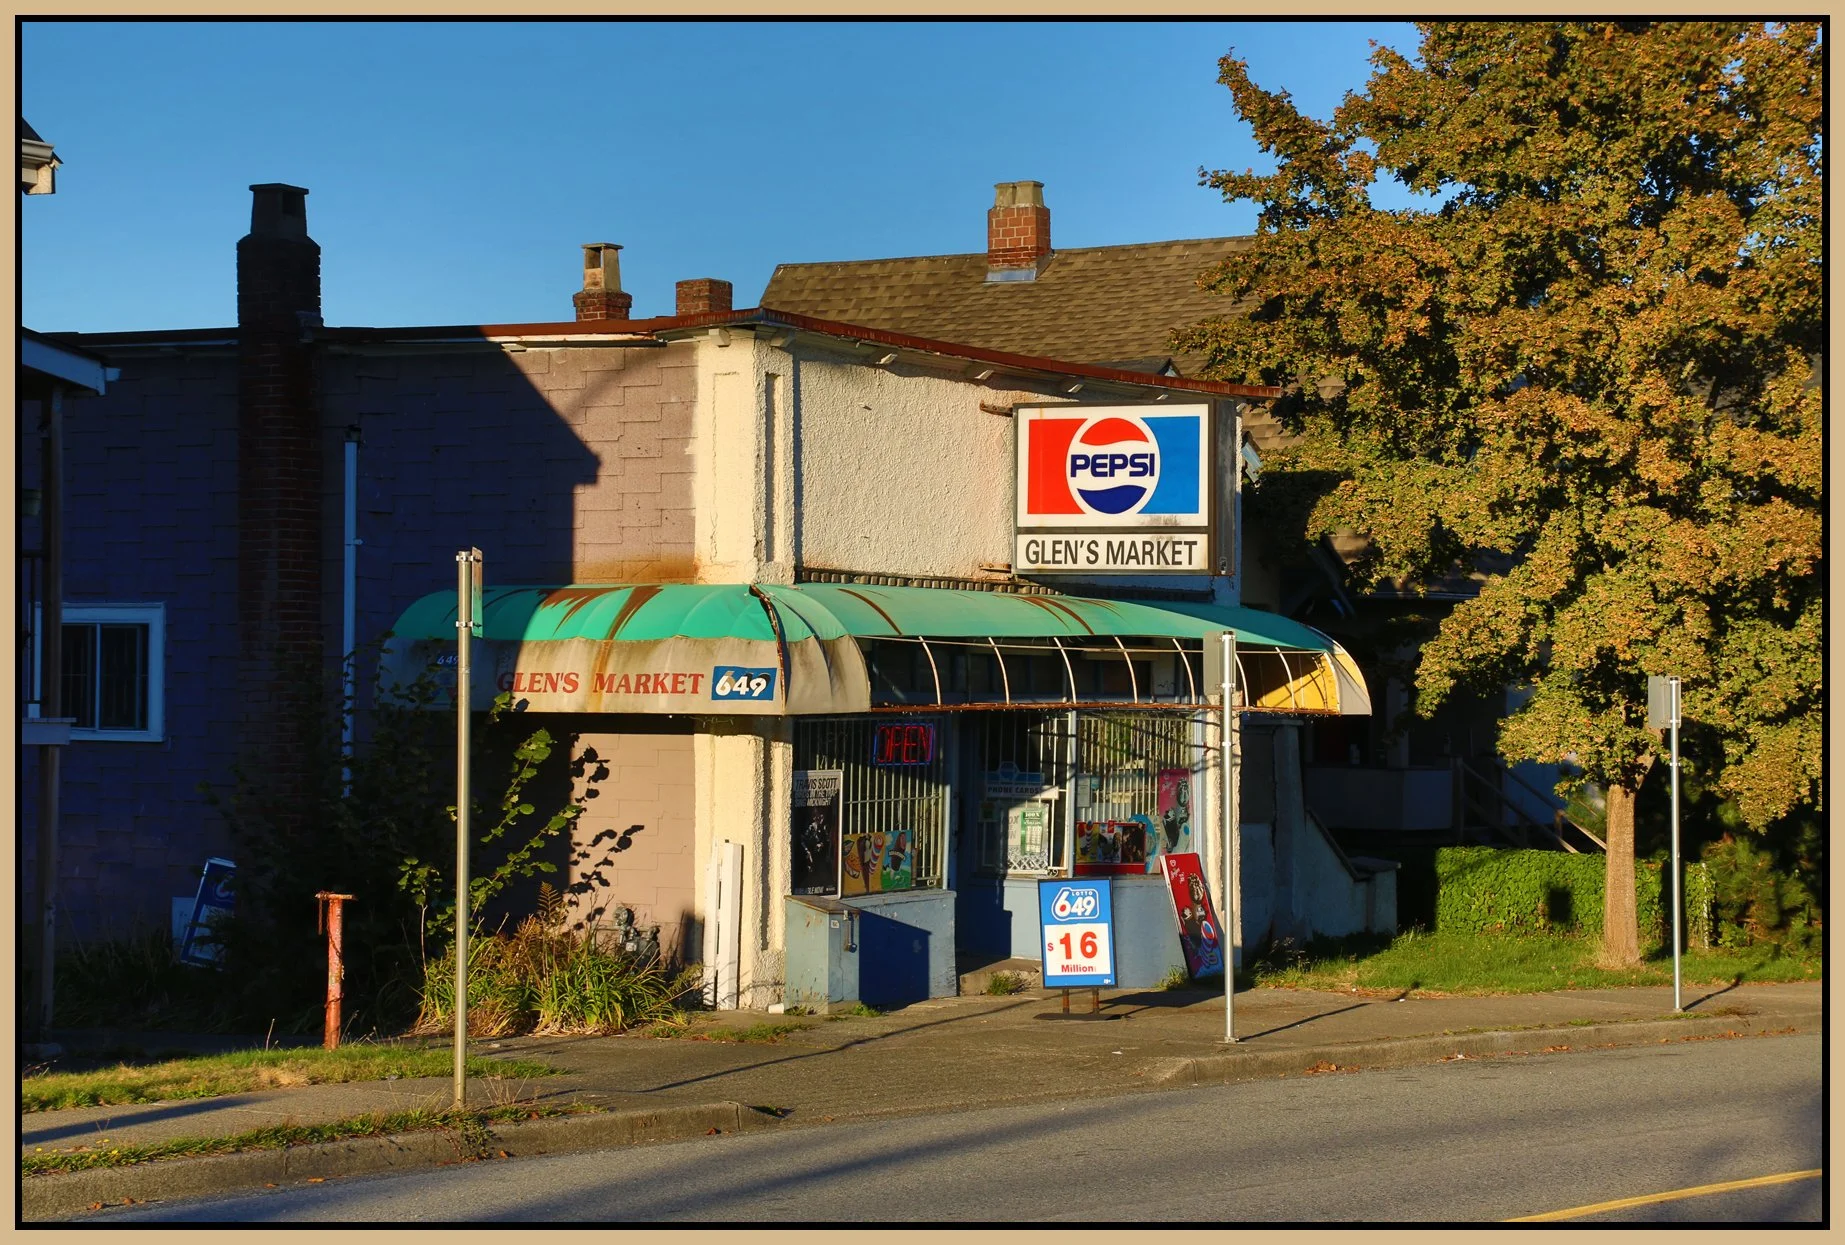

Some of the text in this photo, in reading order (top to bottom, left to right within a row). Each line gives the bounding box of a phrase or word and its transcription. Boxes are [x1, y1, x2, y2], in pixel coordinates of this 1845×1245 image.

[1070, 453, 1155, 478] PEPSI
[1025, 539, 1198, 566] GLEN'S MARKET
[496, 672, 704, 694] GLEN'S MARKET
[716, 671, 769, 697] 649
[877, 725, 932, 764] OPEN
[817, 777, 838, 789] SCOTT
[1055, 891, 1096, 917] 649
[1047, 932, 1098, 960] $ 16
[1061, 964, 1093, 973] Million
